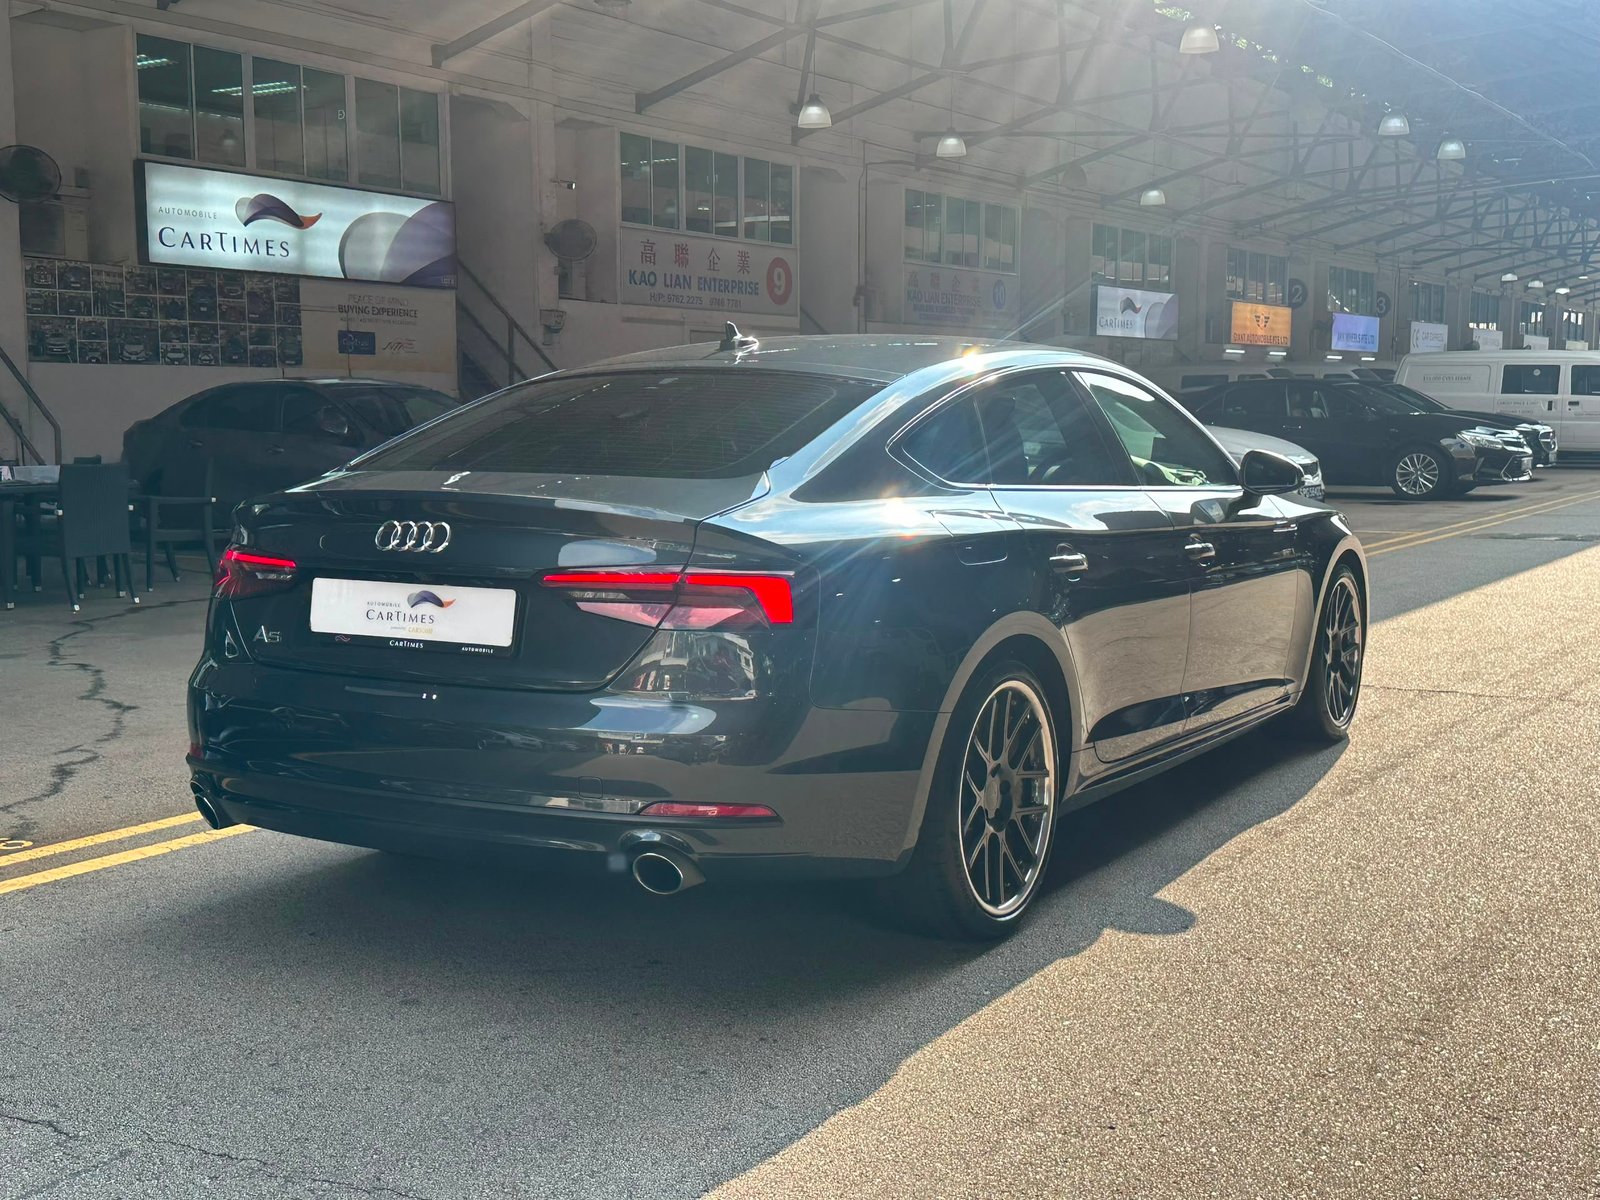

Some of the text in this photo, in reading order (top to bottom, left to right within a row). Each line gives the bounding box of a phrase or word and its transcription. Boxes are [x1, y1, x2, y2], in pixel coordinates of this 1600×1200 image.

[157, 205, 218, 220] AUTOMOBILE
[157, 226, 290, 259] CARTIMES
[640, 239, 752, 276] 高聯企業
[628, 269, 760, 297] KAO LIAN ENTERPRISE
[773, 266, 787, 296] 9
[906, 288, 923, 305] KAO
[1292, 284, 1303, 303] 2
[337, 303, 419, 319] BUYING EXPERIENCE
[1377, 297, 1386, 313] 3
[365, 608, 435, 625] CARTIMES
[252, 625, 281, 643] A5
[389, 639, 424, 650] CARTIMES
[461, 646, 494, 655] AUTOMOBILE
